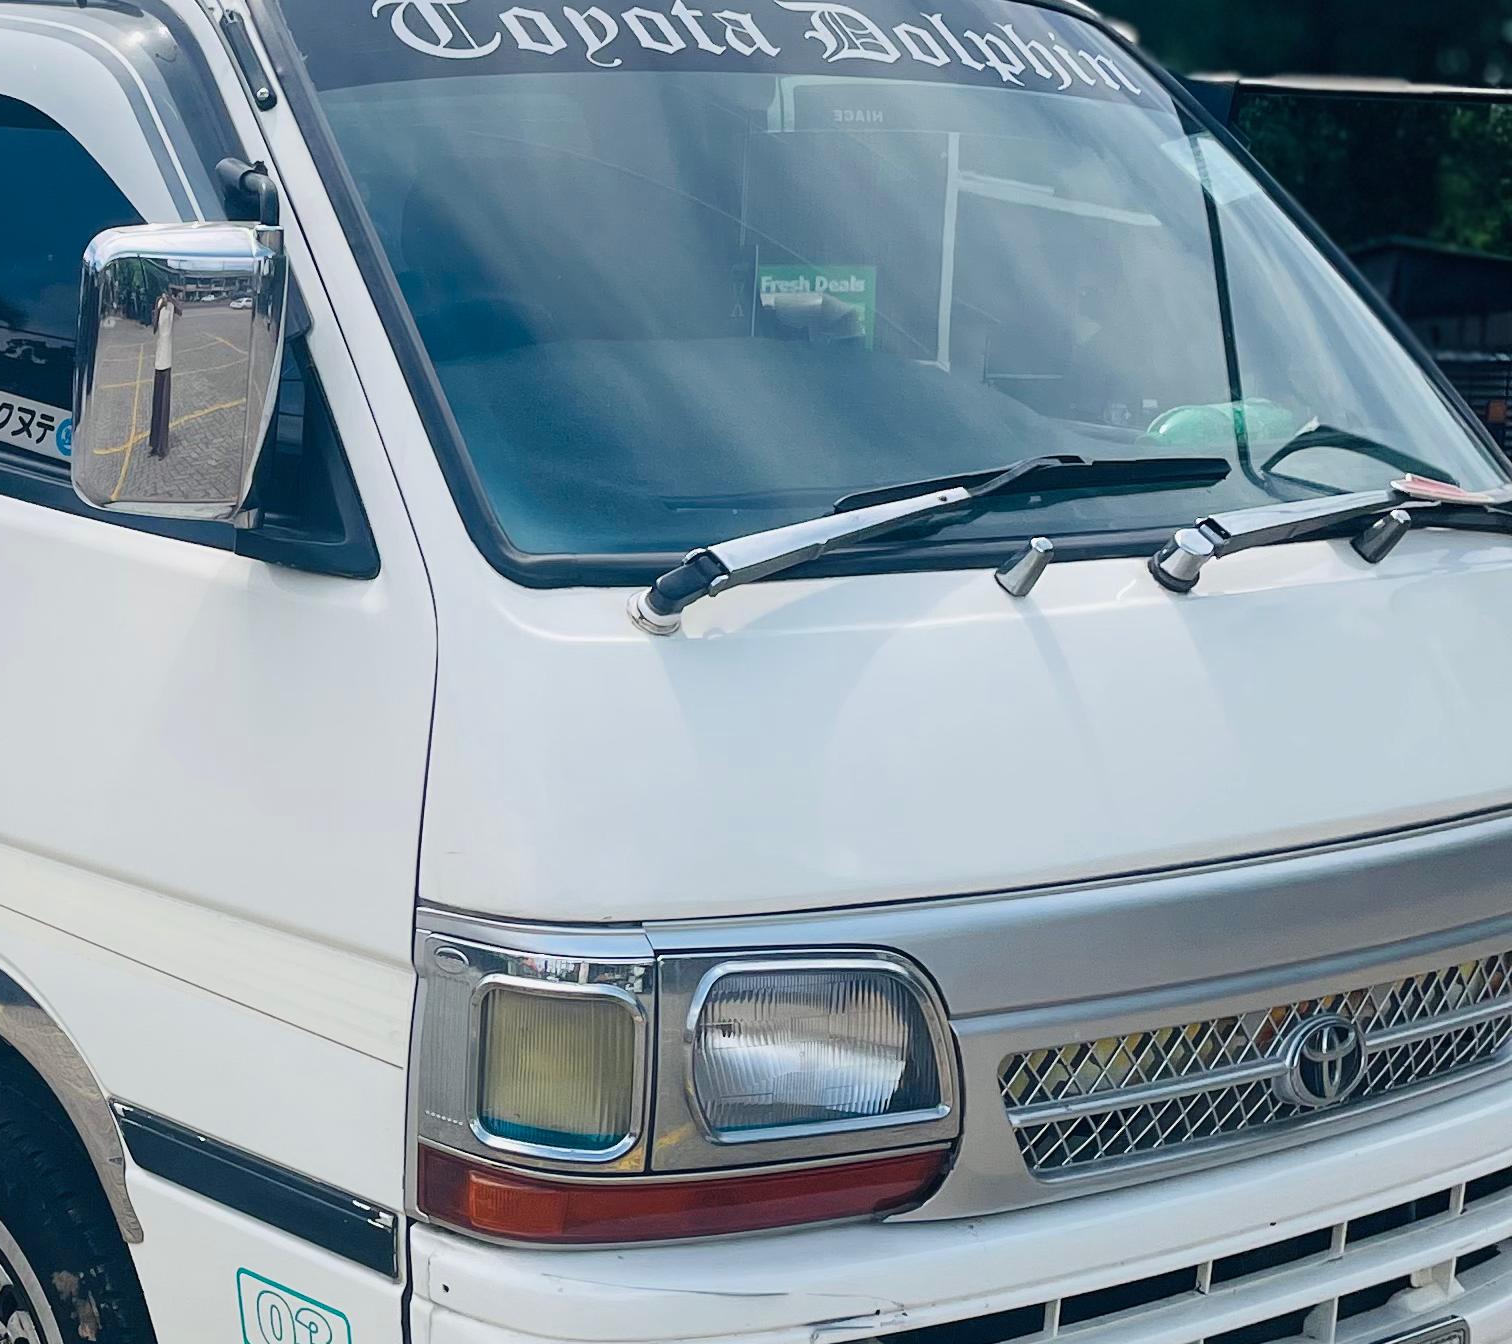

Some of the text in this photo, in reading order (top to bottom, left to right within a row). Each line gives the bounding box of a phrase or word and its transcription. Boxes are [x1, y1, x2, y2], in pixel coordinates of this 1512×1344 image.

[773, 0, 1141, 95] Dolphin
[760, 274, 866, 293] Fresh Deals
